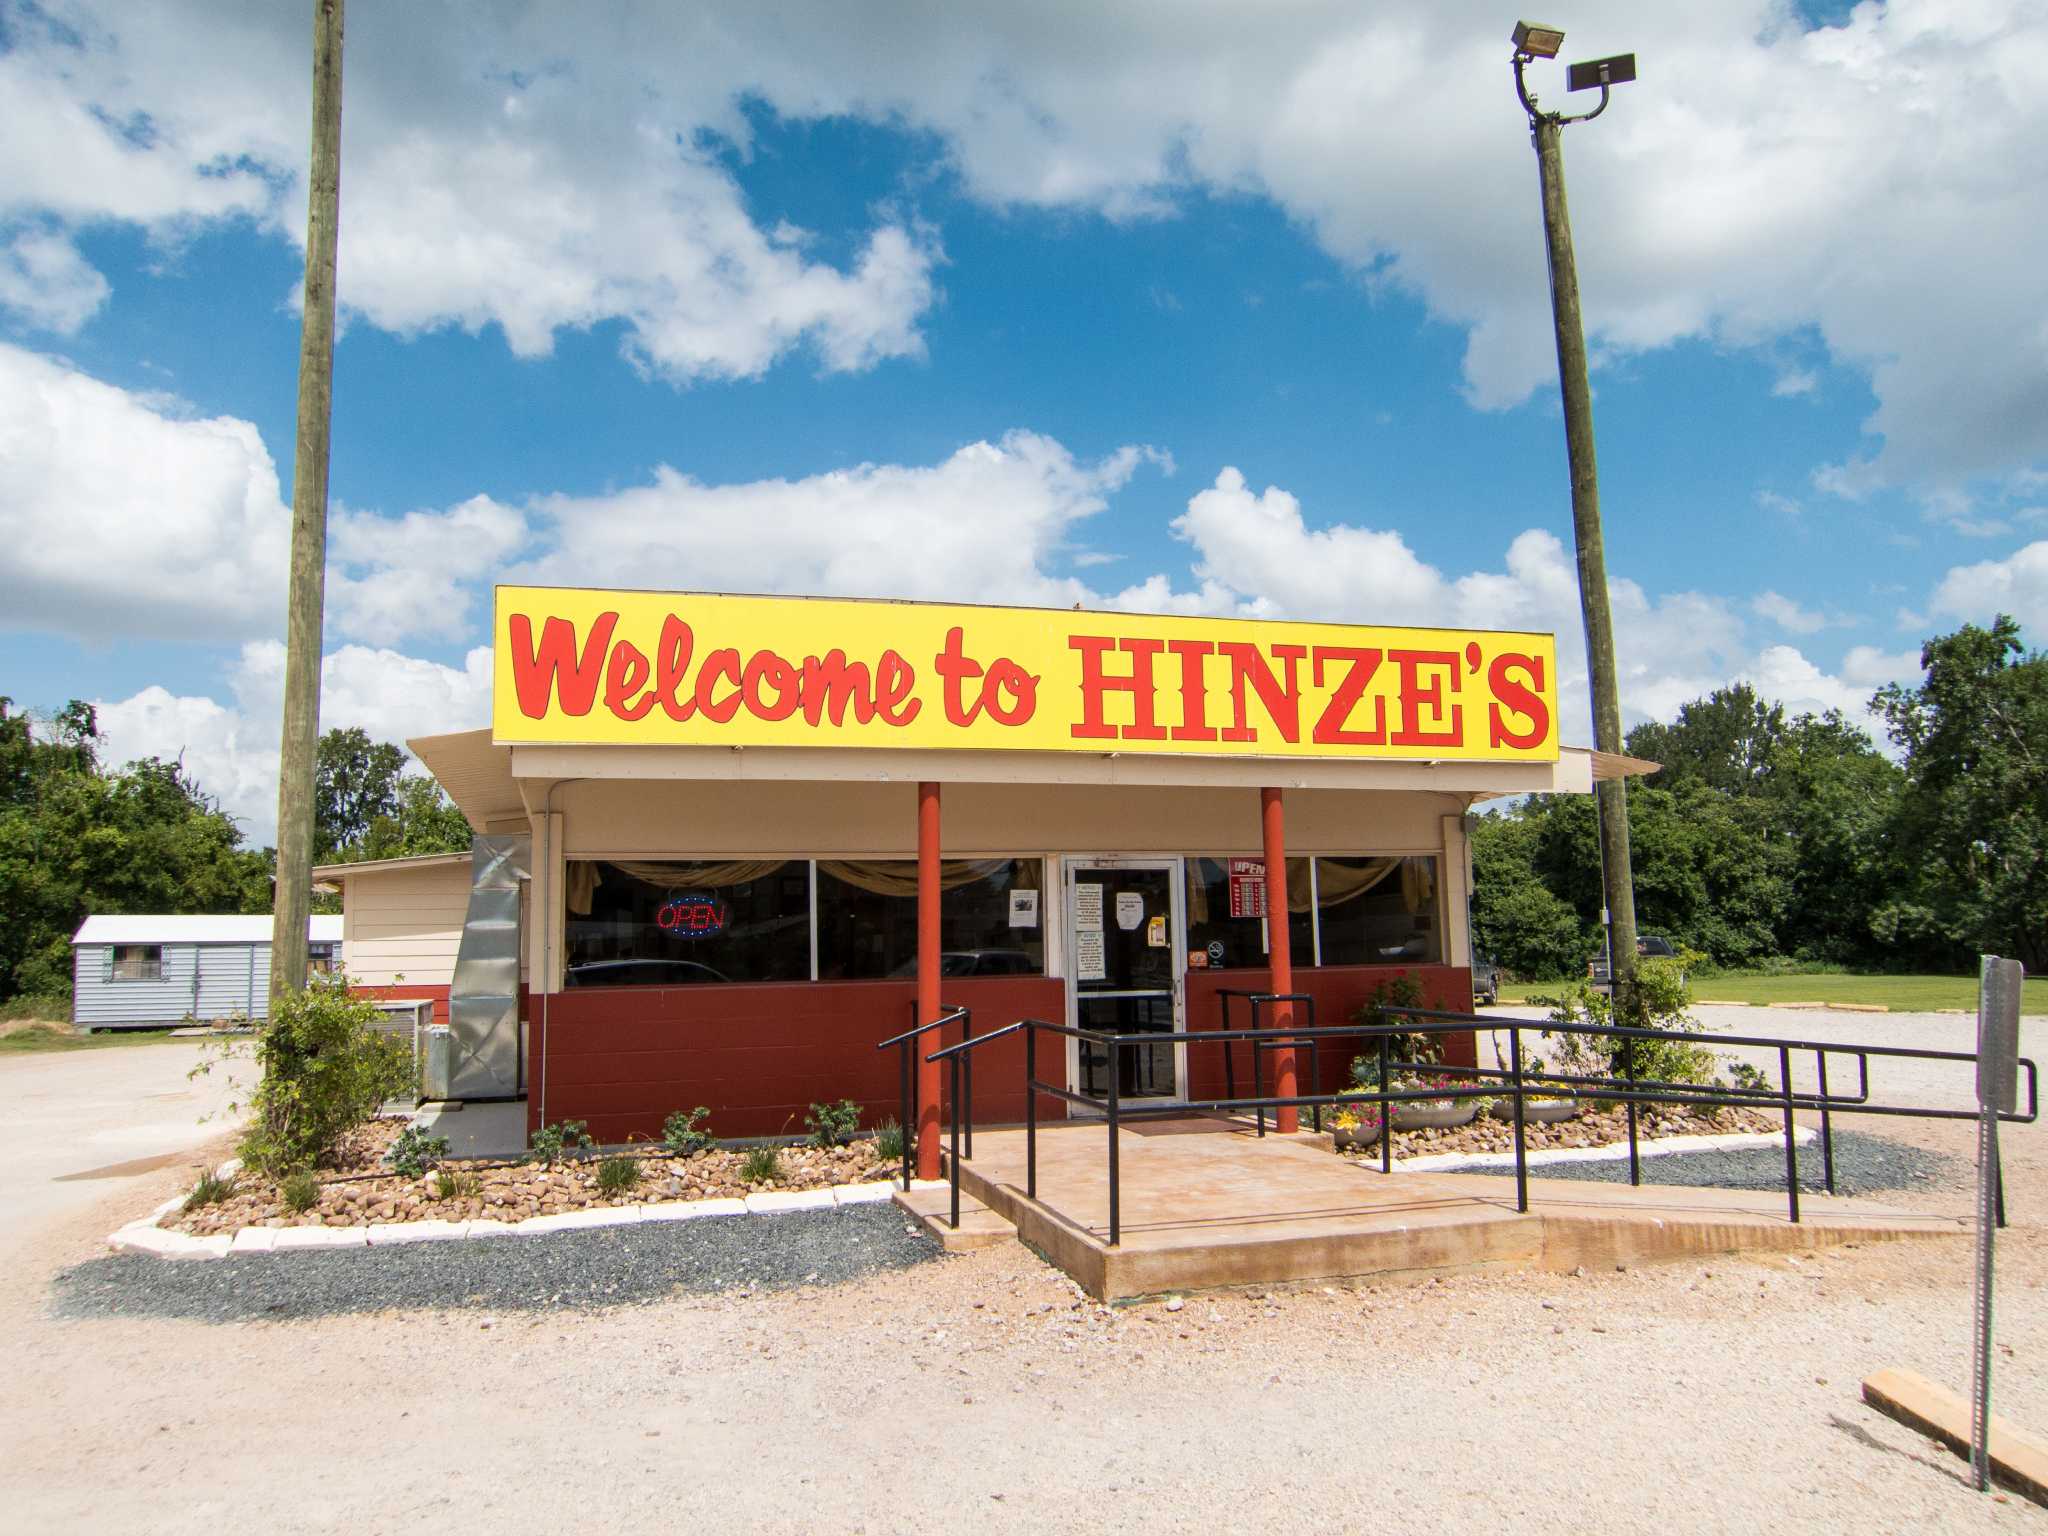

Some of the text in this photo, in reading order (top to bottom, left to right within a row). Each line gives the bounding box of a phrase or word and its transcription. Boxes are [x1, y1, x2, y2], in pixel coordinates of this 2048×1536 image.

[508, 611, 1550, 750] Welcome to HINZE'S
[656, 903, 725, 929] OPEN
